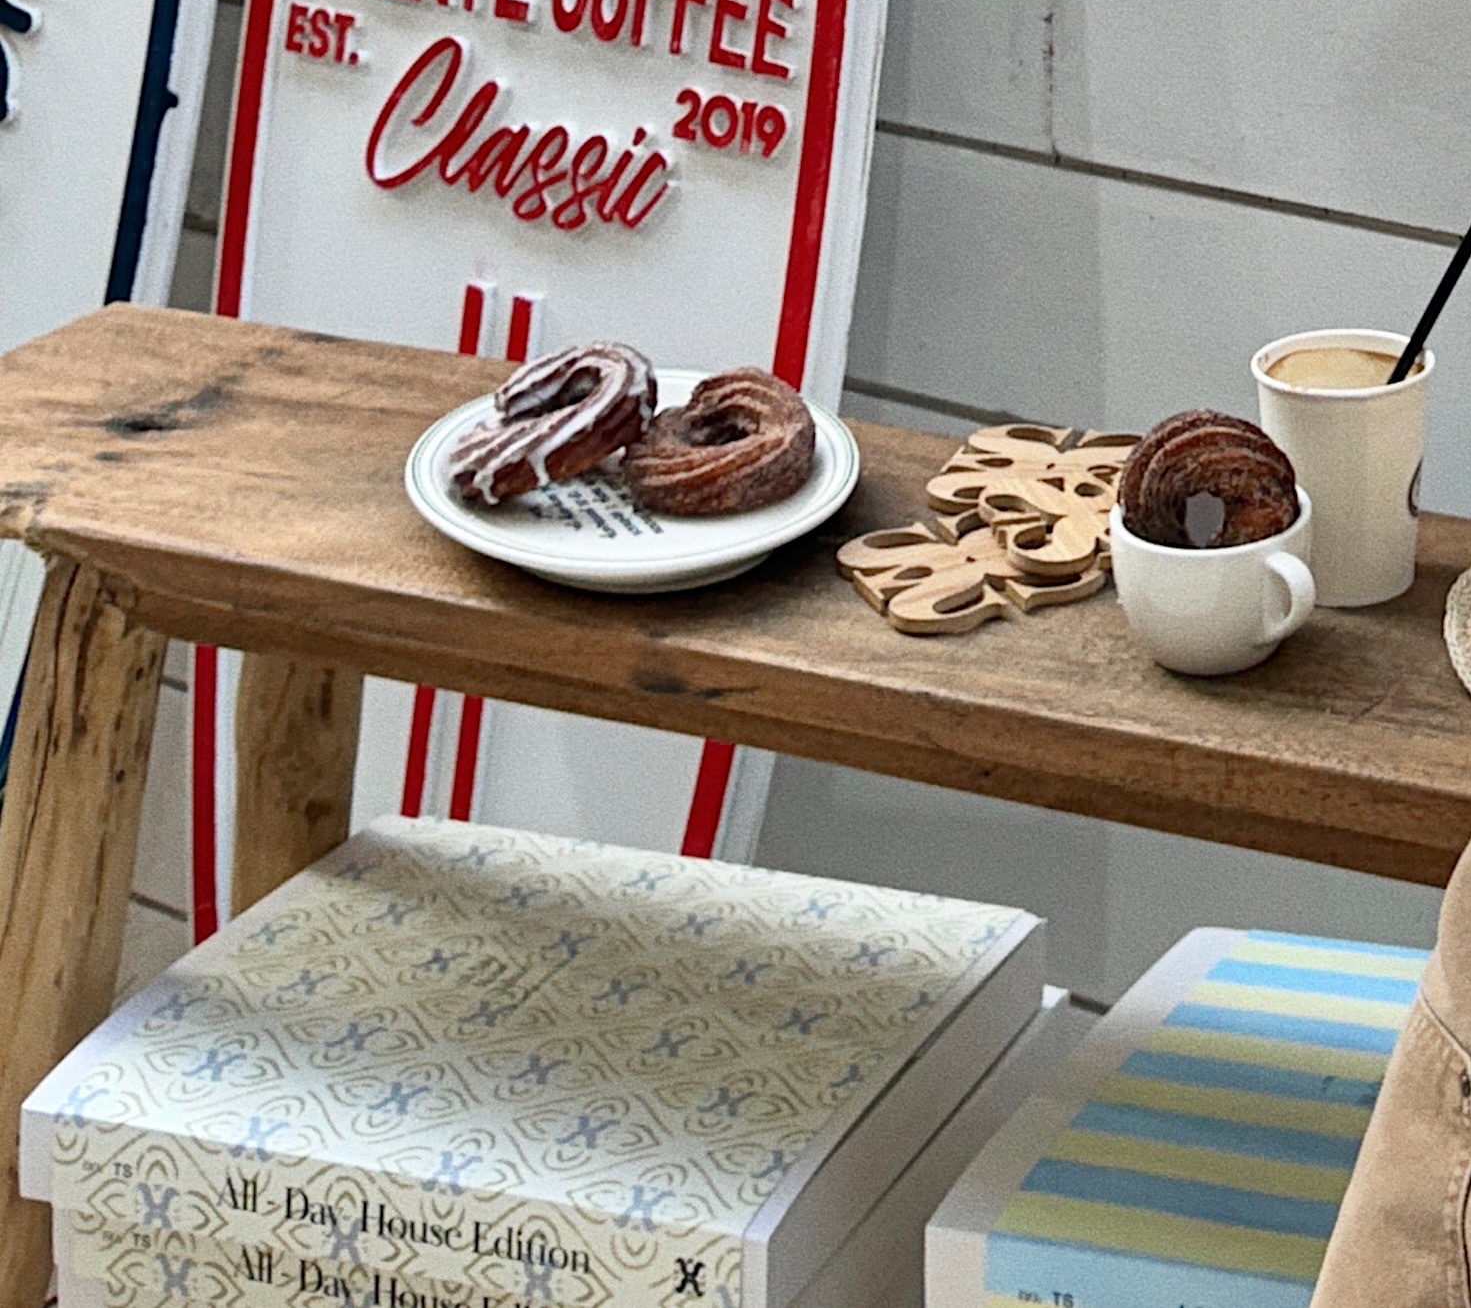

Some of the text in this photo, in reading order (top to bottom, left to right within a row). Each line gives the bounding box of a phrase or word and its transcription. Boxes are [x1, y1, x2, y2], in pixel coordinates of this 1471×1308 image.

[285, 3, 787, 159] EST. 2019
[365, 36, 669, 231] Classic
[216, 1176, 258, 1214] All
[284, 1187, 341, 1235] Day
[360, 1200, 463, 1247] House
[472, 1221, 591, 1274] Edition
[235, 1245, 273, 1284] All
[299, 1259, 353, 1301] Day
